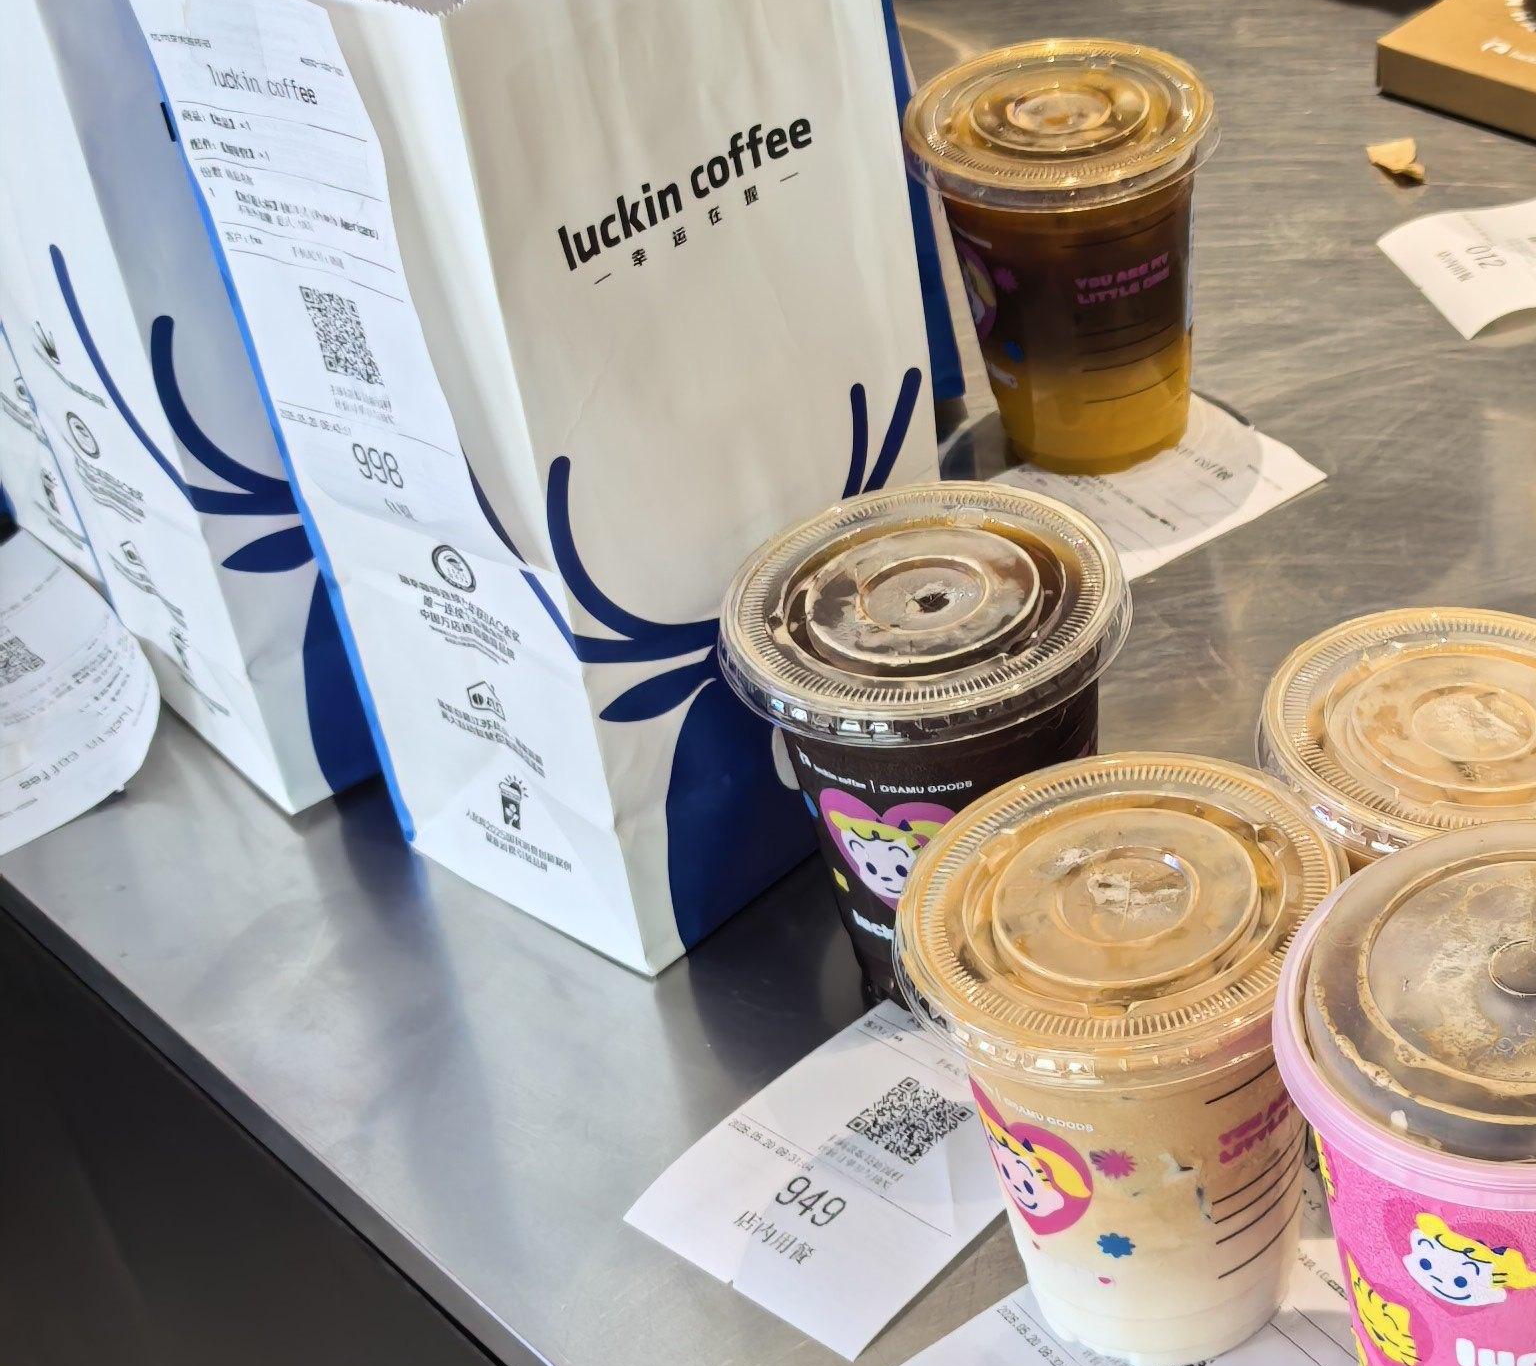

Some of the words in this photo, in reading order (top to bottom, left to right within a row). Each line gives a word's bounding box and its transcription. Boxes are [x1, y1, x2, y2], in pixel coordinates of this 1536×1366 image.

[207, 64, 262, 94] luckin
[266, 77, 318, 105] coffee
[558, 182, 684, 271] luckin
[690, 117, 813, 199] coffee
[632, 185, 760, 267] 幸运在握
[352, 442, 404, 489] 998
[852, 908, 896, 941] luc
[773, 1168, 848, 1234] 949
